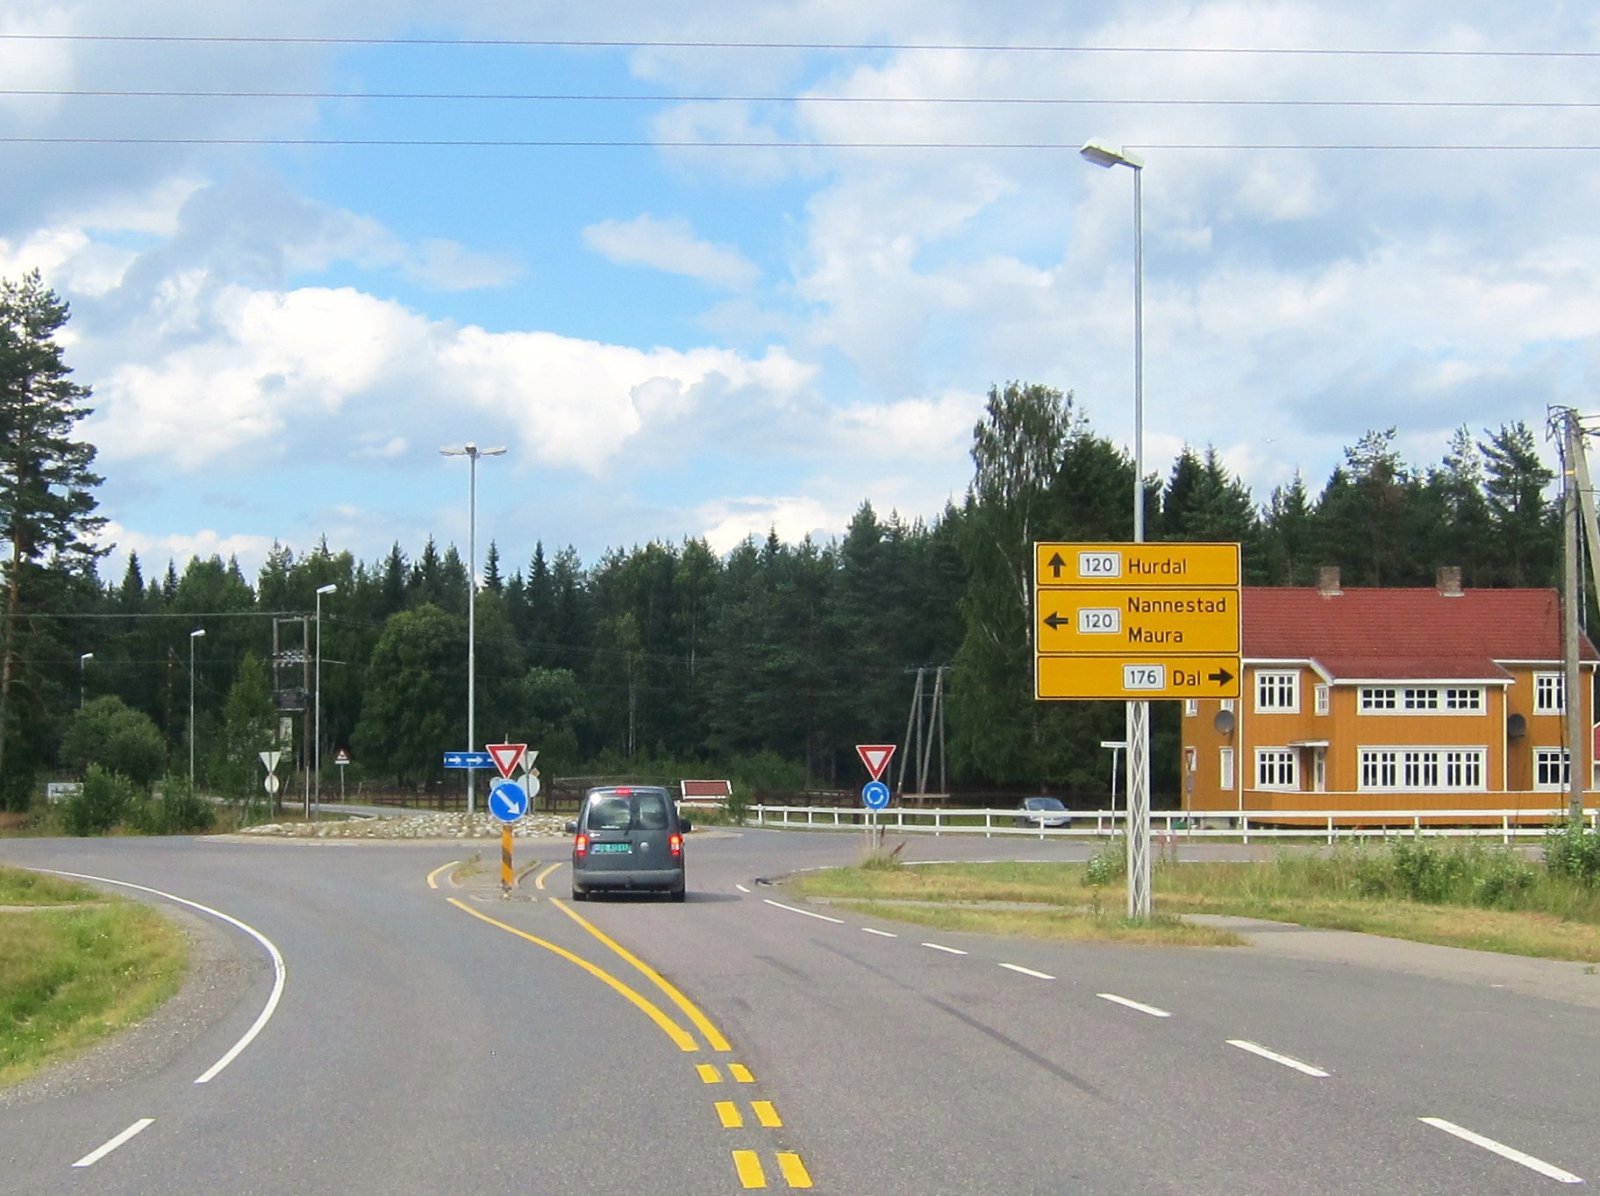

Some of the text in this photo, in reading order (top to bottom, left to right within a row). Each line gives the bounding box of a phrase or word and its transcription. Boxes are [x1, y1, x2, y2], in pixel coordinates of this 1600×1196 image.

[1085, 558, 1187, 575] 120 Hurdal
[1128, 597, 1226, 613] Nannestad
[1085, 614, 1113, 628] 120
[1128, 627, 1183, 643] Maura
[1129, 670, 1201, 686] 176 Dal
